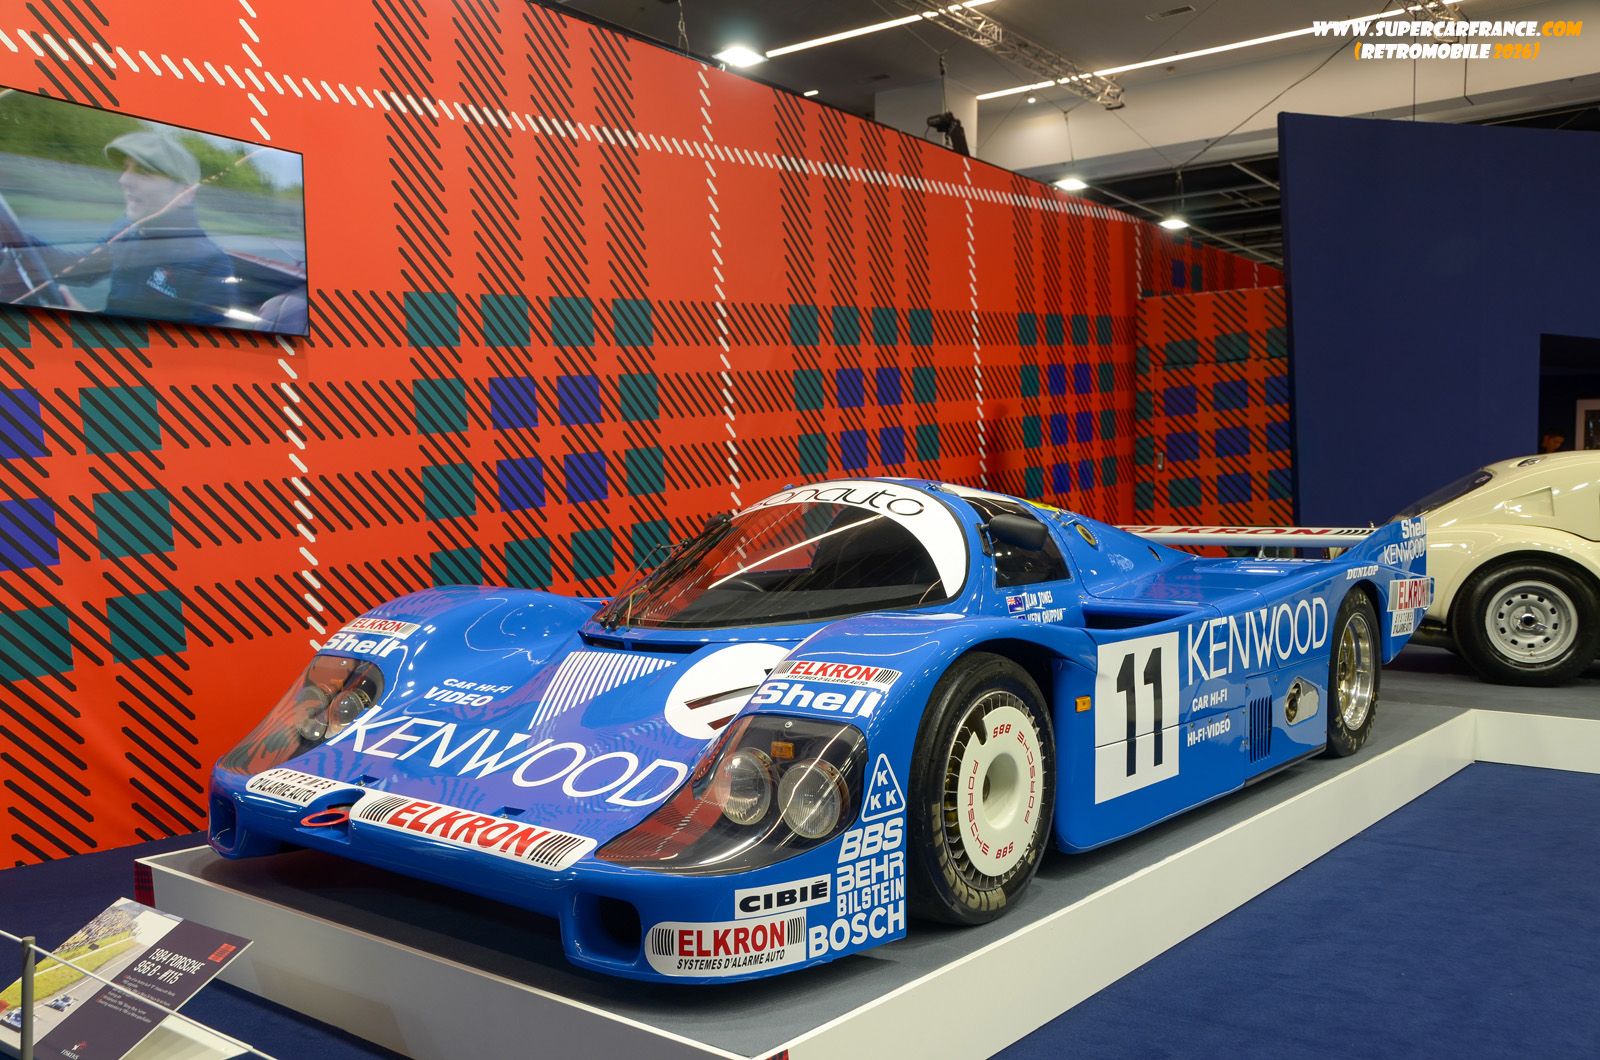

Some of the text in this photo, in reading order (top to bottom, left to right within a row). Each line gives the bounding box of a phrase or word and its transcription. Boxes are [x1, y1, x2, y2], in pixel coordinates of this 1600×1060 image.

[750, 487, 925, 516] onauto
[1120, 527, 1332, 535] ELKRON
[1401, 516, 1427, 539] Shell
[1384, 538, 1425, 565] KENWOOD
[1346, 565, 1379, 580] DUNLOP
[1398, 580, 1426, 609] ELKRON
[352, 618, 407, 633] ELKRON
[322, 633, 401, 658] Shell
[1188, 597, 1328, 686] KENWOOD
[790, 661, 880, 681] ELKRON
[424, 687, 494, 707] VIDEO
[443, 678, 512, 695] CAR HI-FI
[751, 682, 883, 718] Shell
[1117, 646, 1163, 778] 11
[1192, 688, 1228, 712] CAR HI-FI
[993, 723, 1012, 739] BBS
[326, 705, 688, 807] KENWOOD
[268, 769, 337, 790] SYSTEMES
[877, 769, 888, 786] K
[1017, 731, 1036, 825] PORSCHE
[286, 787, 317, 802] AUTO
[870, 790, 898, 811] K K
[967, 759, 990, 855] PORSCHE
[387, 801, 551, 857] ELKRON
[838, 817, 904, 864] BBS
[995, 841, 1014, 859] BBS
[836, 851, 904, 894] BEHR
[836, 877, 904, 918] BILSTEIN
[678, 920, 785, 957] ELKRON
[808, 900, 905, 959] BOSCH
[133, 959, 156, 974] 956
[147, 964, 161, 976] B
[148, 948, 206, 975] 1984 PORSCHE
[677, 949, 785, 970] SYSTEMES D'ALARME AUTO
